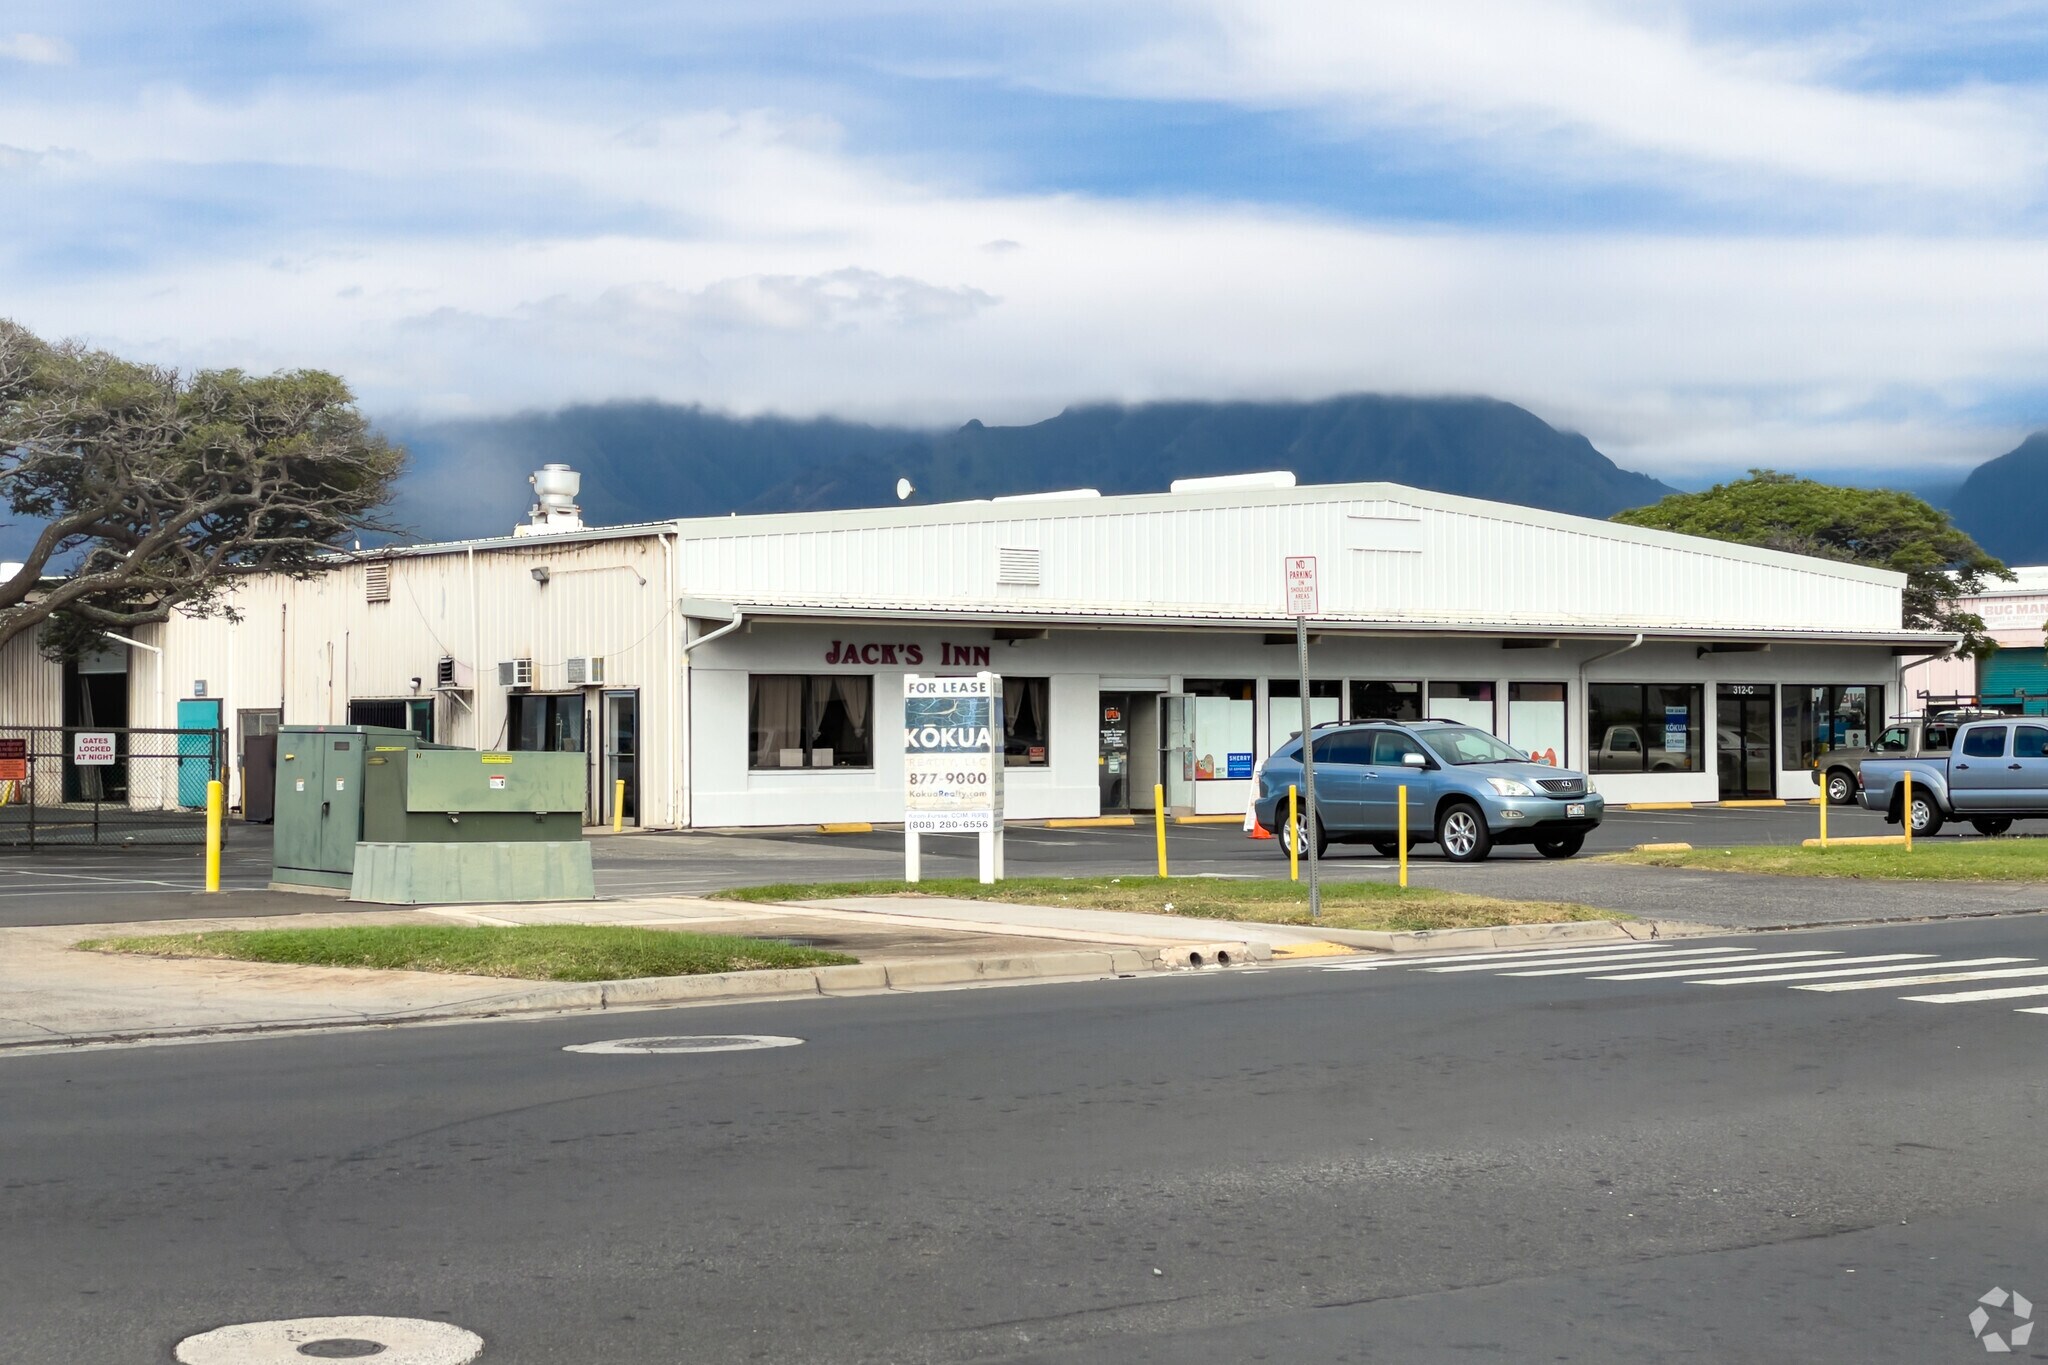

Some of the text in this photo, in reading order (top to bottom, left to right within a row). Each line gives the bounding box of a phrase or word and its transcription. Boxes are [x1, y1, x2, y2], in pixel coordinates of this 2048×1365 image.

[1295, 560, 1305, 569] NO
[1290, 570, 1312, 579] PARKING
[1984, 605, 2013, 616] BUG
[825, 640, 991, 667] JACK'S INN
[908, 682, 937, 694] FOR
[942, 682, 987, 693] LEASE
[1732, 685, 1754, 695] 312-C
[909, 772, 987, 785] 877-9000
[909, 790, 987, 800] KokuaRealty.com
[909, 820, 989, 830] (808) 280-6556
